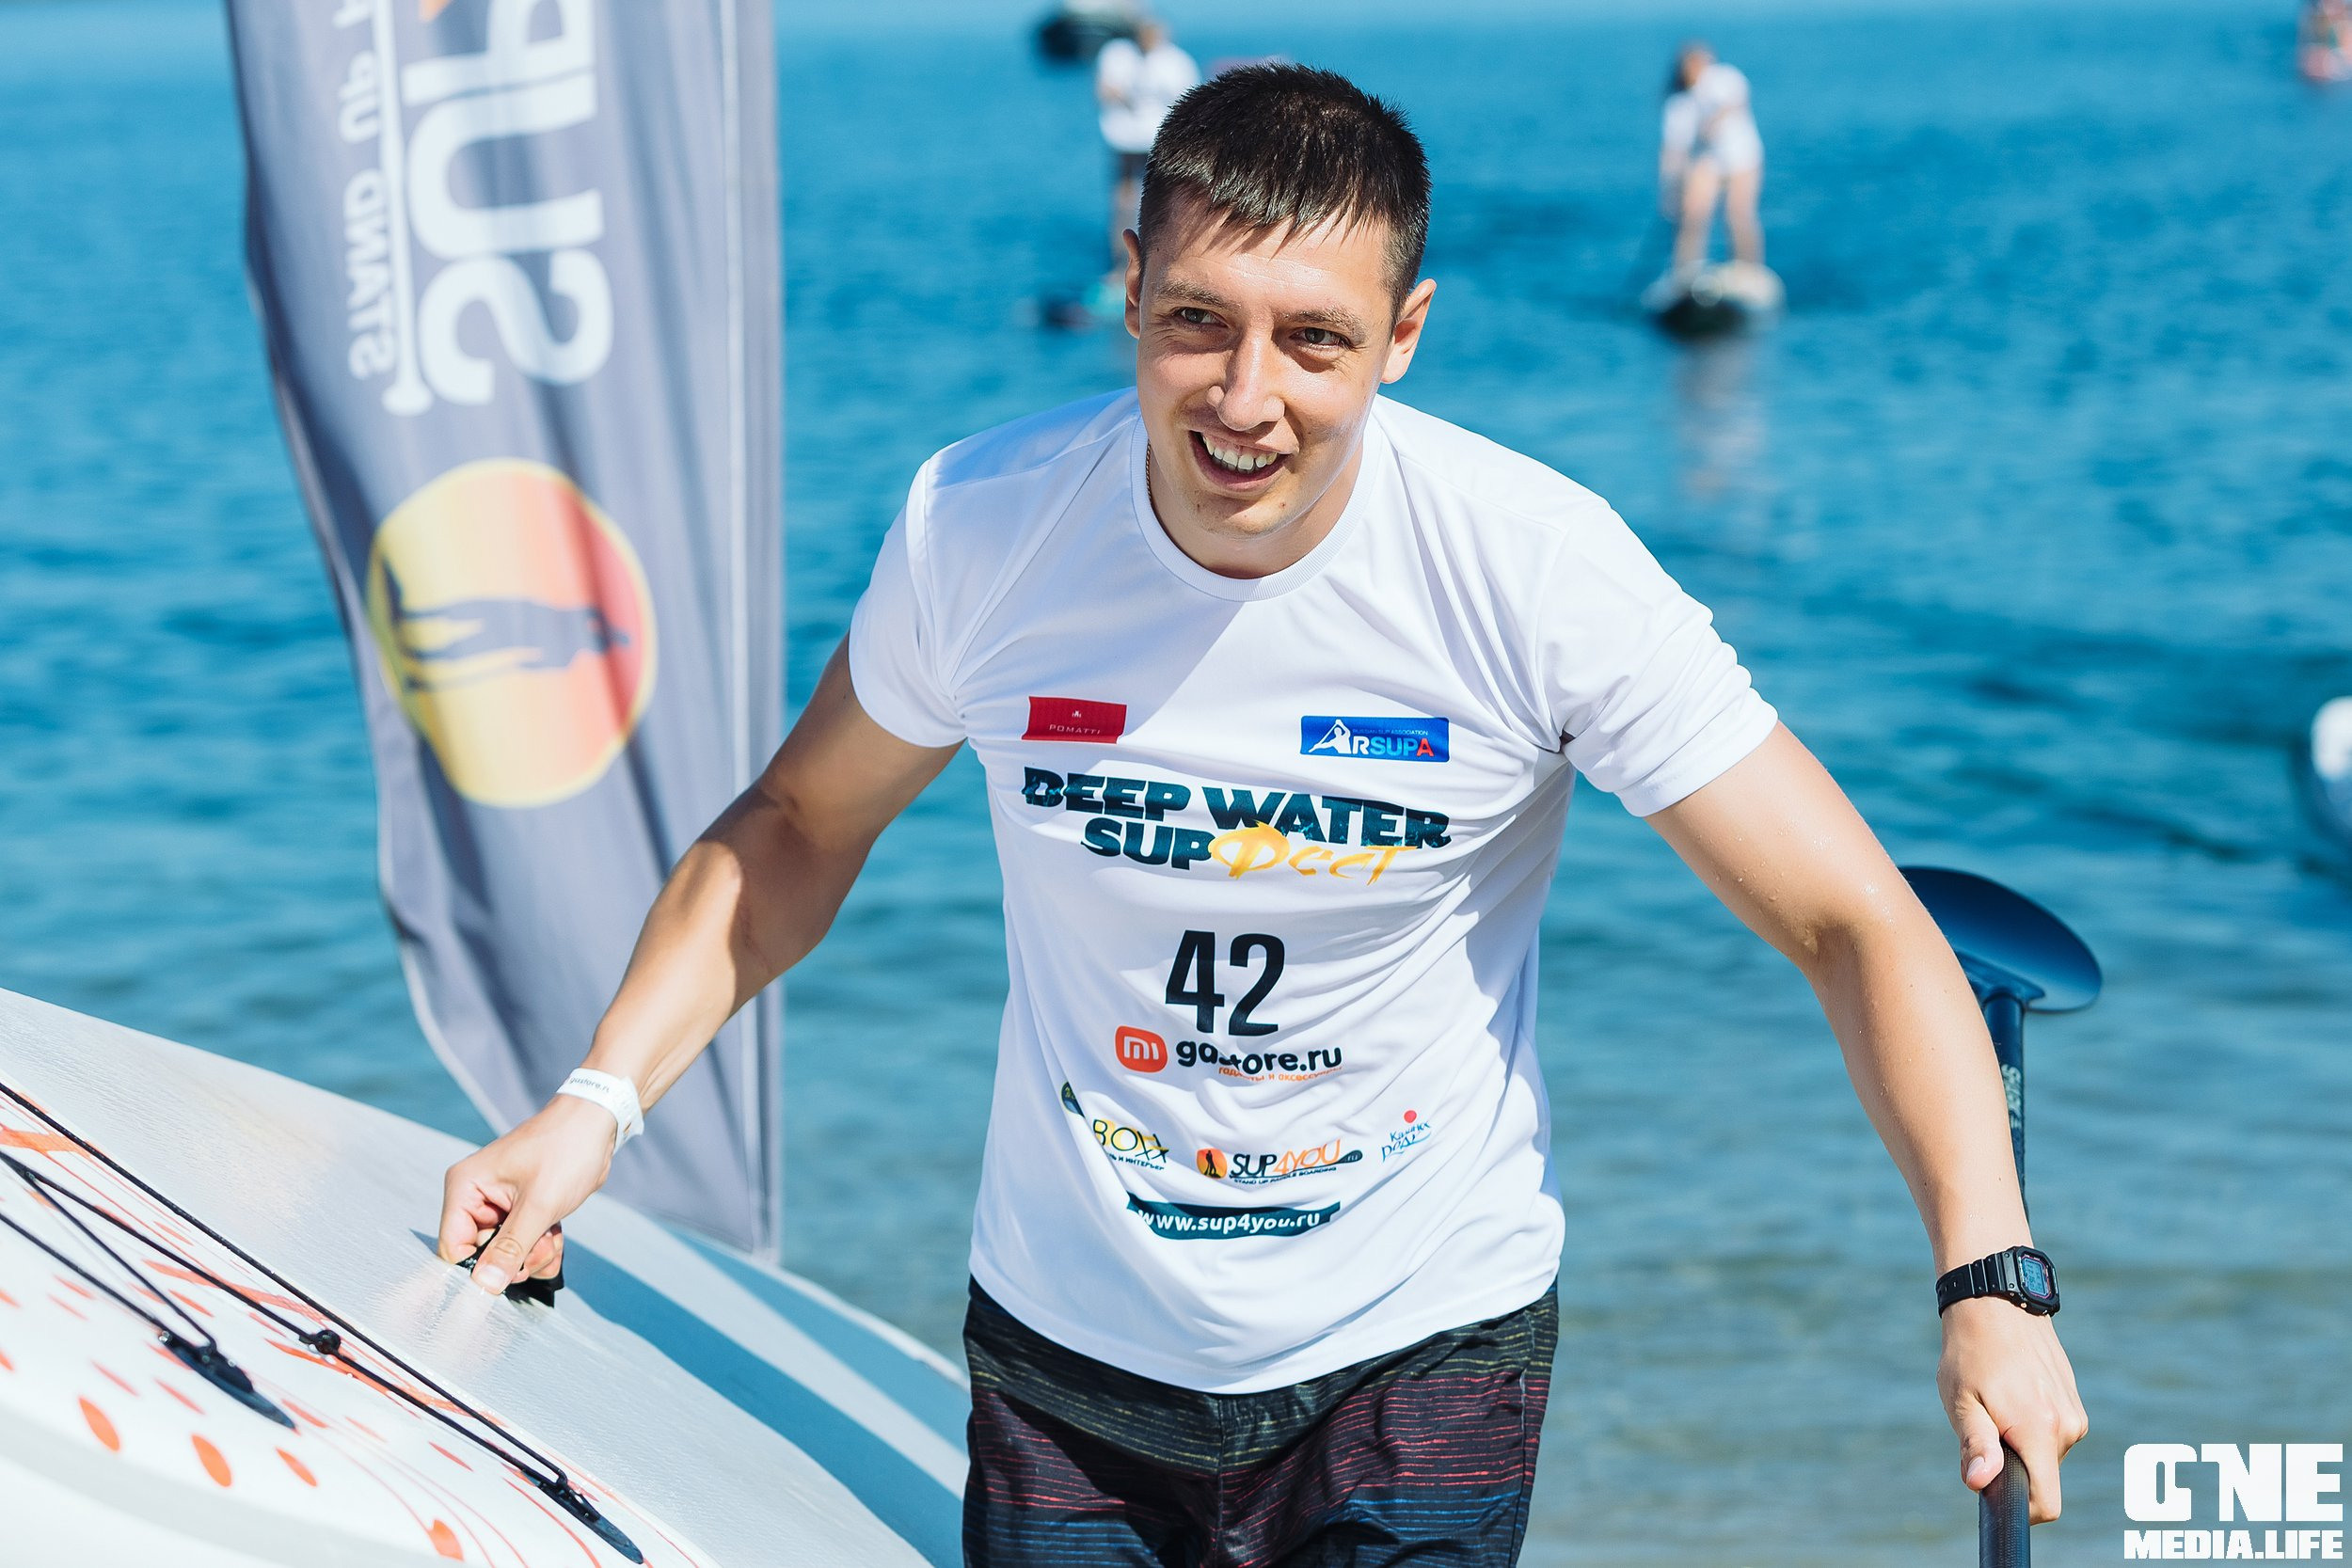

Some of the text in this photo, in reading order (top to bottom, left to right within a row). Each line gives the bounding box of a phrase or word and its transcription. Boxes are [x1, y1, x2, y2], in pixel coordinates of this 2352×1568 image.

[1048, 723, 1101, 735] POMATTI
[1020, 766, 1453, 849] DEEP WATER
[1080, 816, 1215, 871] SUP
[1165, 929, 1285, 1037] 42
[1230, 1138, 1341, 1176] SUP4YOU
[1270, 1172, 1296, 1183] PADDLE
[1299, 1166, 1337, 1177] BOARDING
[1136, 1209, 1320, 1235] www.sup4you.ru
